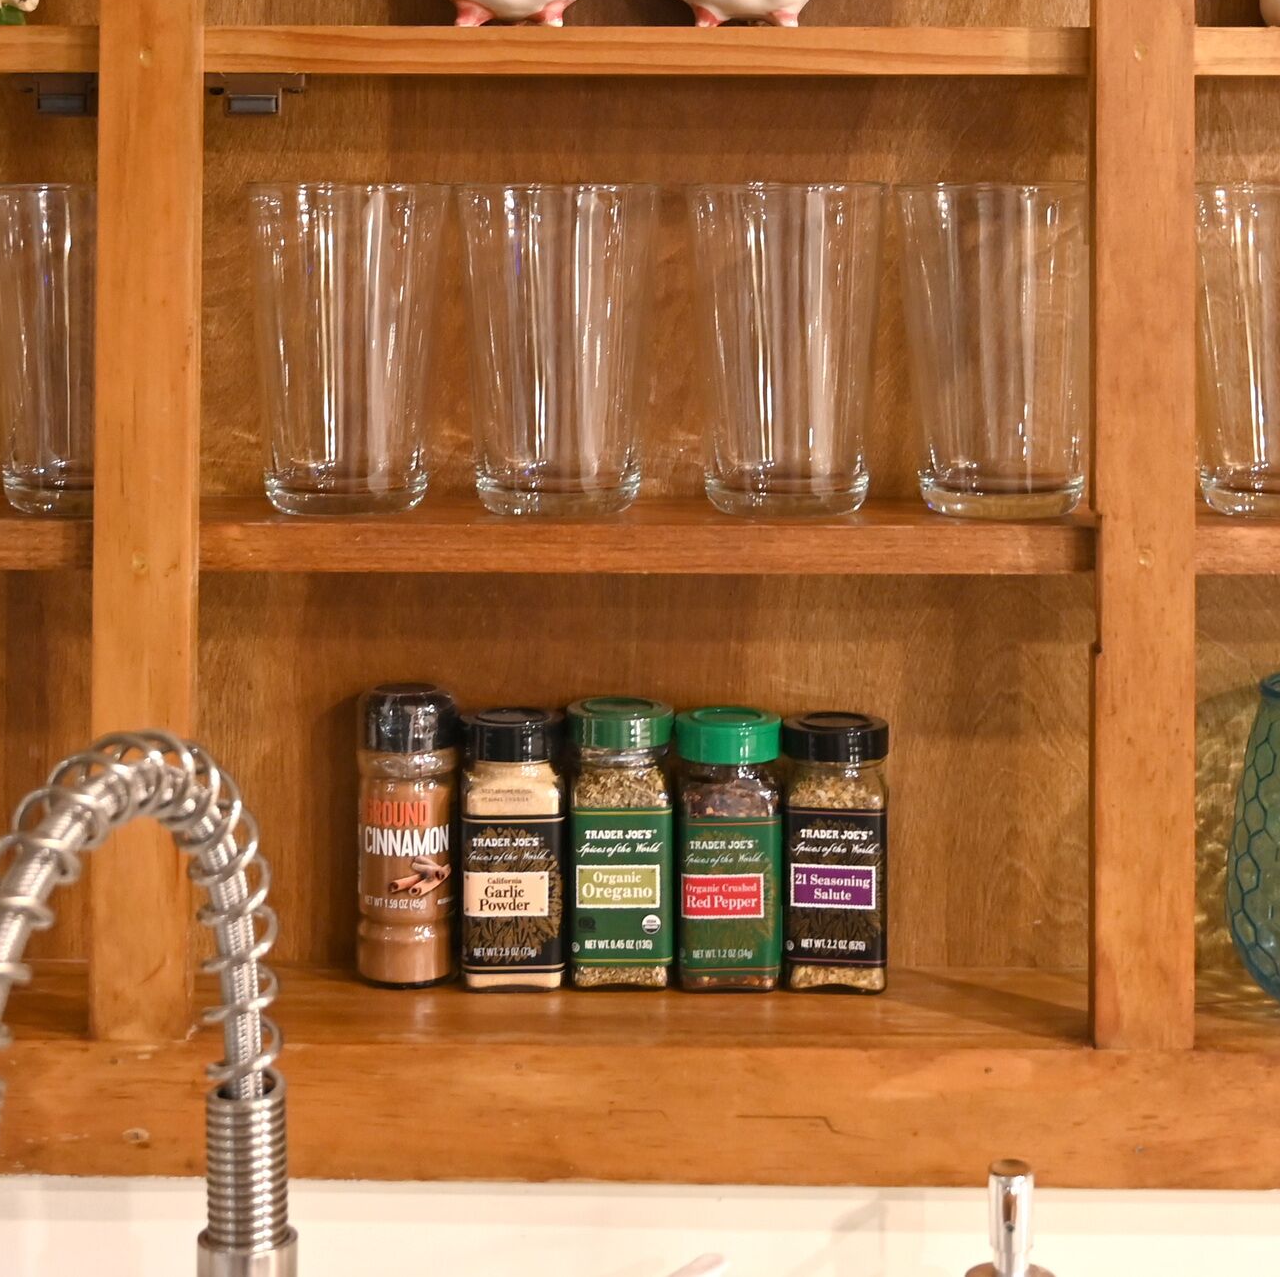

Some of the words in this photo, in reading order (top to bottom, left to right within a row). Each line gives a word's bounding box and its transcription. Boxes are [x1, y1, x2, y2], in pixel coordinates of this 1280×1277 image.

[365, 824, 449, 857] CINNAMON
[585, 830, 623, 839] TRADER
[625, 830, 652, 839] JOE'S
[800, 829, 839, 839] TRADER
[841, 830, 868, 840] JOE'S
[472, 837, 510, 847] TRADER
[512, 837, 540, 847] JOE'S
[689, 840, 726, 850] TRADER
[727, 840, 754, 849] JOE'S
[576, 843, 605, 857] Spices
[607, 843, 620, 857] of
[635, 842, 663, 853] World
[791, 842, 820, 856] Spices
[822, 843, 835, 857] of
[487, 877, 522, 885] California
[593, 871, 642, 885] Organic
[795, 874, 807, 885] 21
[810, 874, 871, 889] Seasoning
[484, 885, 524, 898] Garlic
[582, 883, 653, 900] Oregano
[685, 883, 719, 894] Organic
[721, 883, 757, 892] Crushed
[814, 888, 852, 901] Salute
[478, 898, 530, 911] Powder
[687, 895, 711, 908] Red
[713, 895, 758, 910] Pepper
[585, 939, 597, 949] NET
[801, 939, 813, 948] NET
[473, 948, 485, 956] NET
